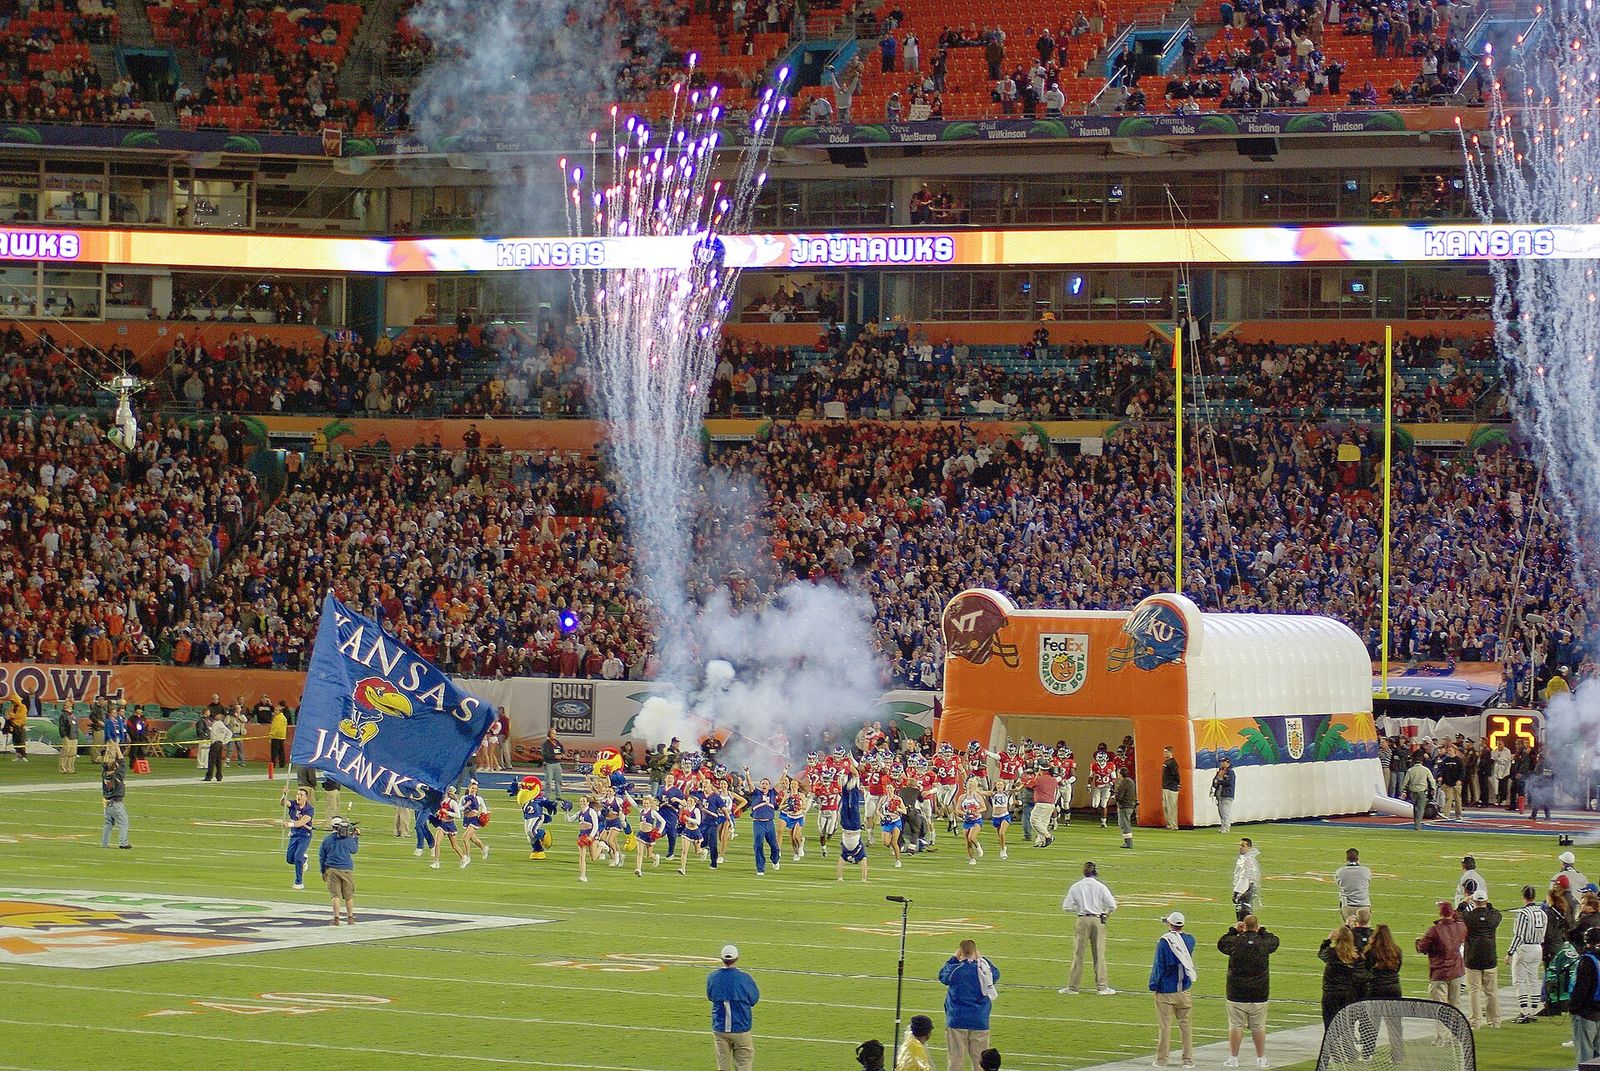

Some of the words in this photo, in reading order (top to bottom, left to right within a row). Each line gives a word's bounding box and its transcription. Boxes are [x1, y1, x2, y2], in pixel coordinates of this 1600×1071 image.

[1079, 127, 1111, 138] Namath
[1172, 124, 1195, 134] Nobis
[1248, 123, 1280, 135] Harding
[1332, 122, 1364, 132] Hudson
[829, 134, 850, 143] Dodd
[900, 133, 937, 142] VanBuren
[988, 130, 1027, 139] Wilkinson
[791, 236, 954, 264] JAYHAWKS
[1424, 229, 1555, 257] KANSAS
[497, 242, 605, 267] KANSAS
[950, 610, 984, 634] VT
[1145, 618, 1176, 642] KU
[1043, 637, 1084, 651] FedEx
[1042, 652, 1067, 691] ORANGE
[1070, 653, 1085, 689] BOWL
[552, 683, 593, 700] BUILT
[551, 717, 592, 731] TOUGH
[1489, 716, 1535, 750] 25
[938, 766, 956, 779] 84
[820, 794, 837, 806] 27
